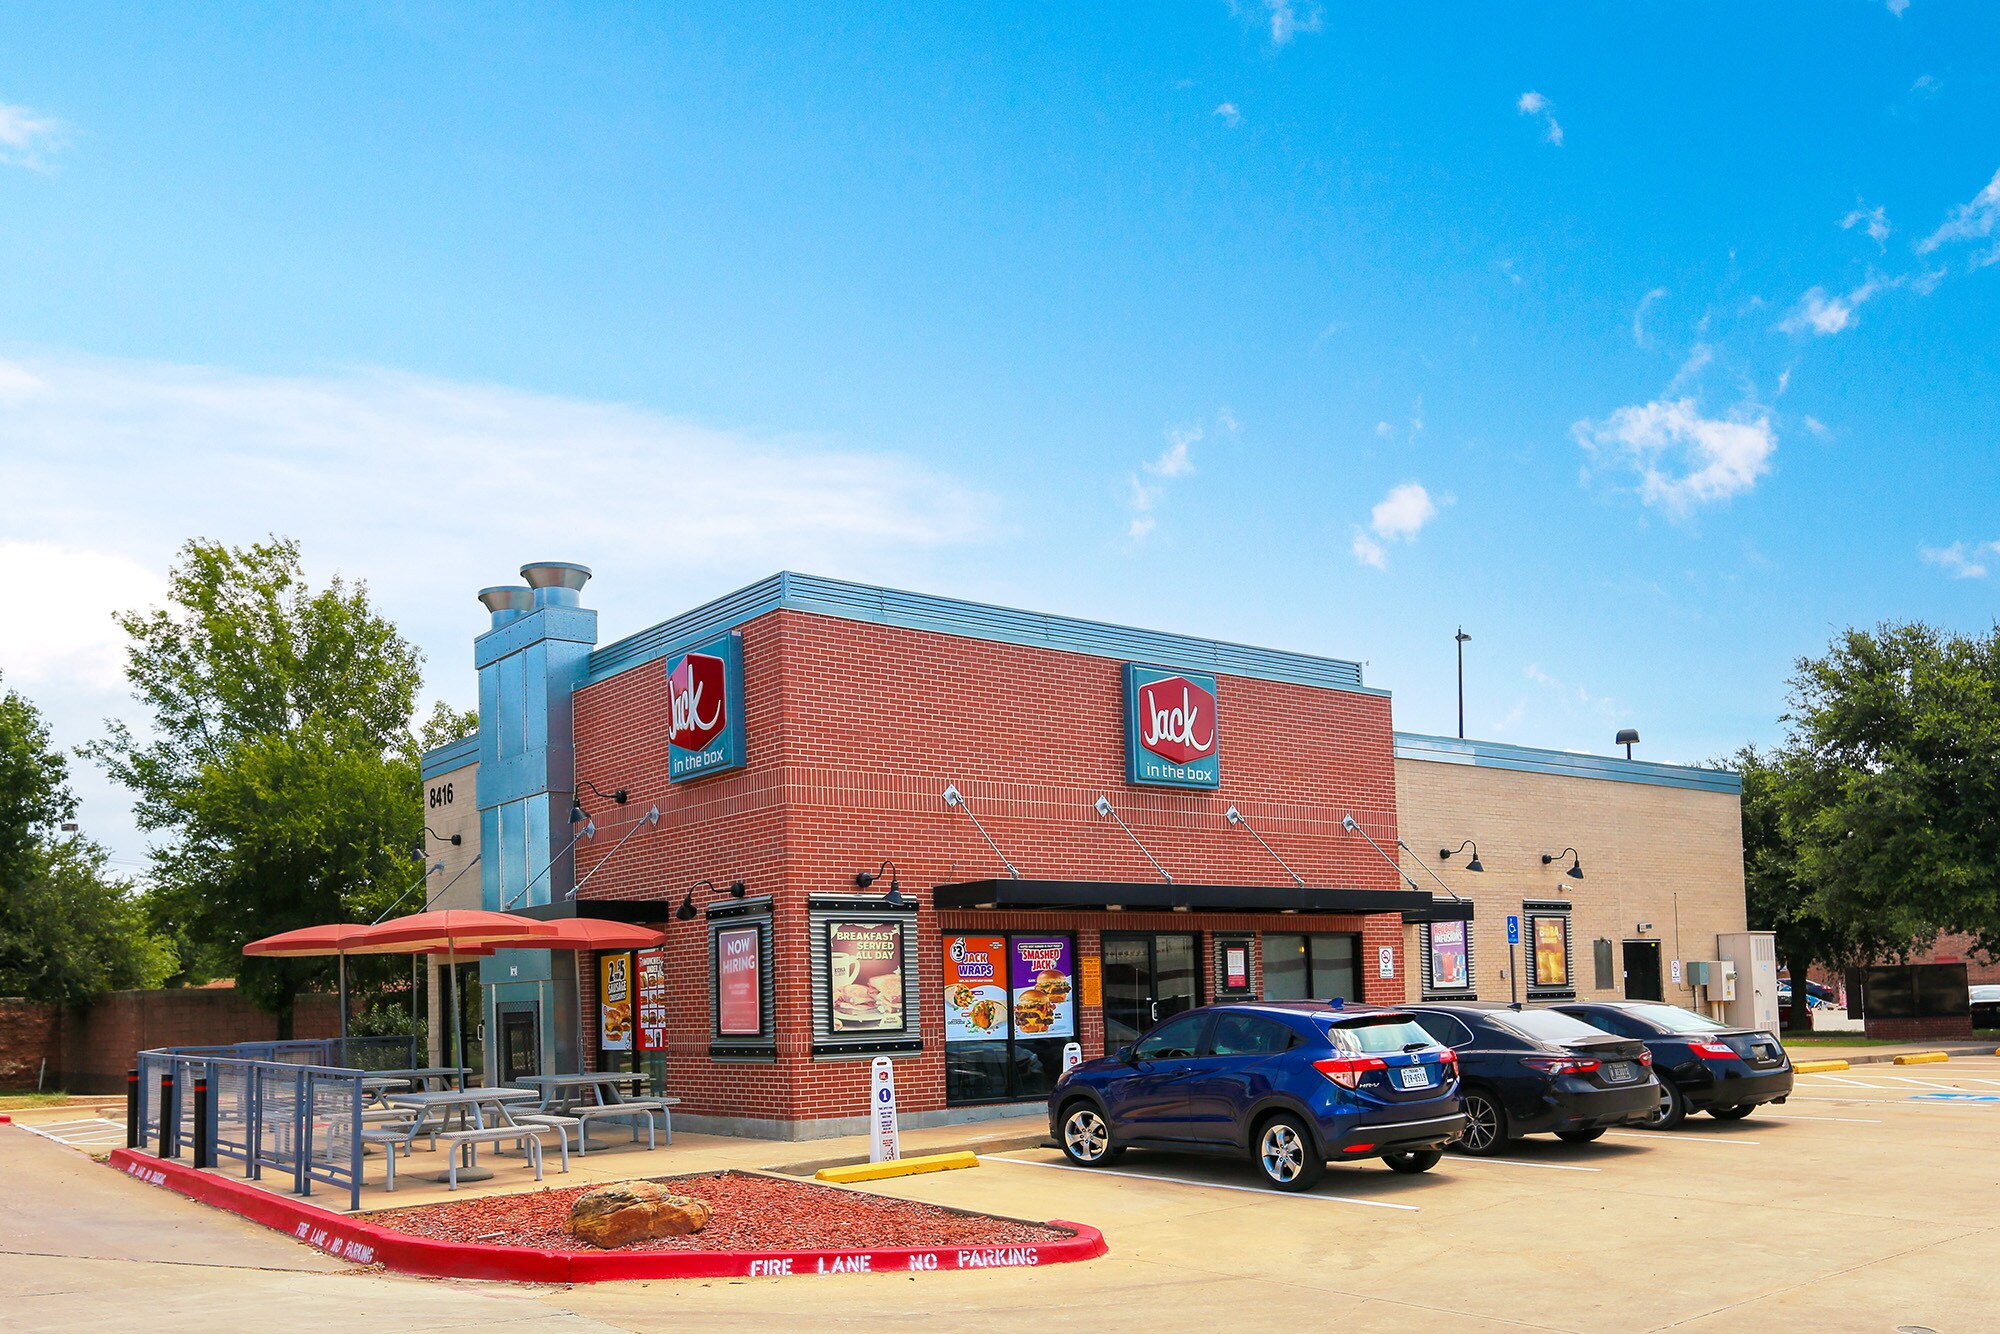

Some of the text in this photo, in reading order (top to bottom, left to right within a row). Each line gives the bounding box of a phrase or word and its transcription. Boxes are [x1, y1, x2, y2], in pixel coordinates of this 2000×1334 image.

[669, 664, 721, 740] Jack
[1144, 687, 1214, 751] Jack
[674, 751, 723, 773] in the box
[1147, 763, 1211, 781] in the box
[430, 783, 453, 808] 8416
[837, 932, 894, 941] BREAKFAST
[727, 938, 750, 955] NOW
[857, 942, 894, 950] SERVED
[953, 946, 963, 957] $3
[856, 951, 895, 960] ALL DAY
[963, 953, 987, 963] JACK
[1023, 949, 1060, 960] SMASHED
[608, 961, 614, 982] 2
[723, 955, 755, 974] HIRING
[959, 965, 993, 976] WRAPS
[1032, 960, 1051, 970] JACK
[608, 981, 627, 994] SAUSAGE
[882, 1090, 888, 1101] 1
[295, 1222, 375, 1262] FIRE LANE NO PARKING
[750, 1247, 1038, 1277] FIRE LANE NO PARKING
